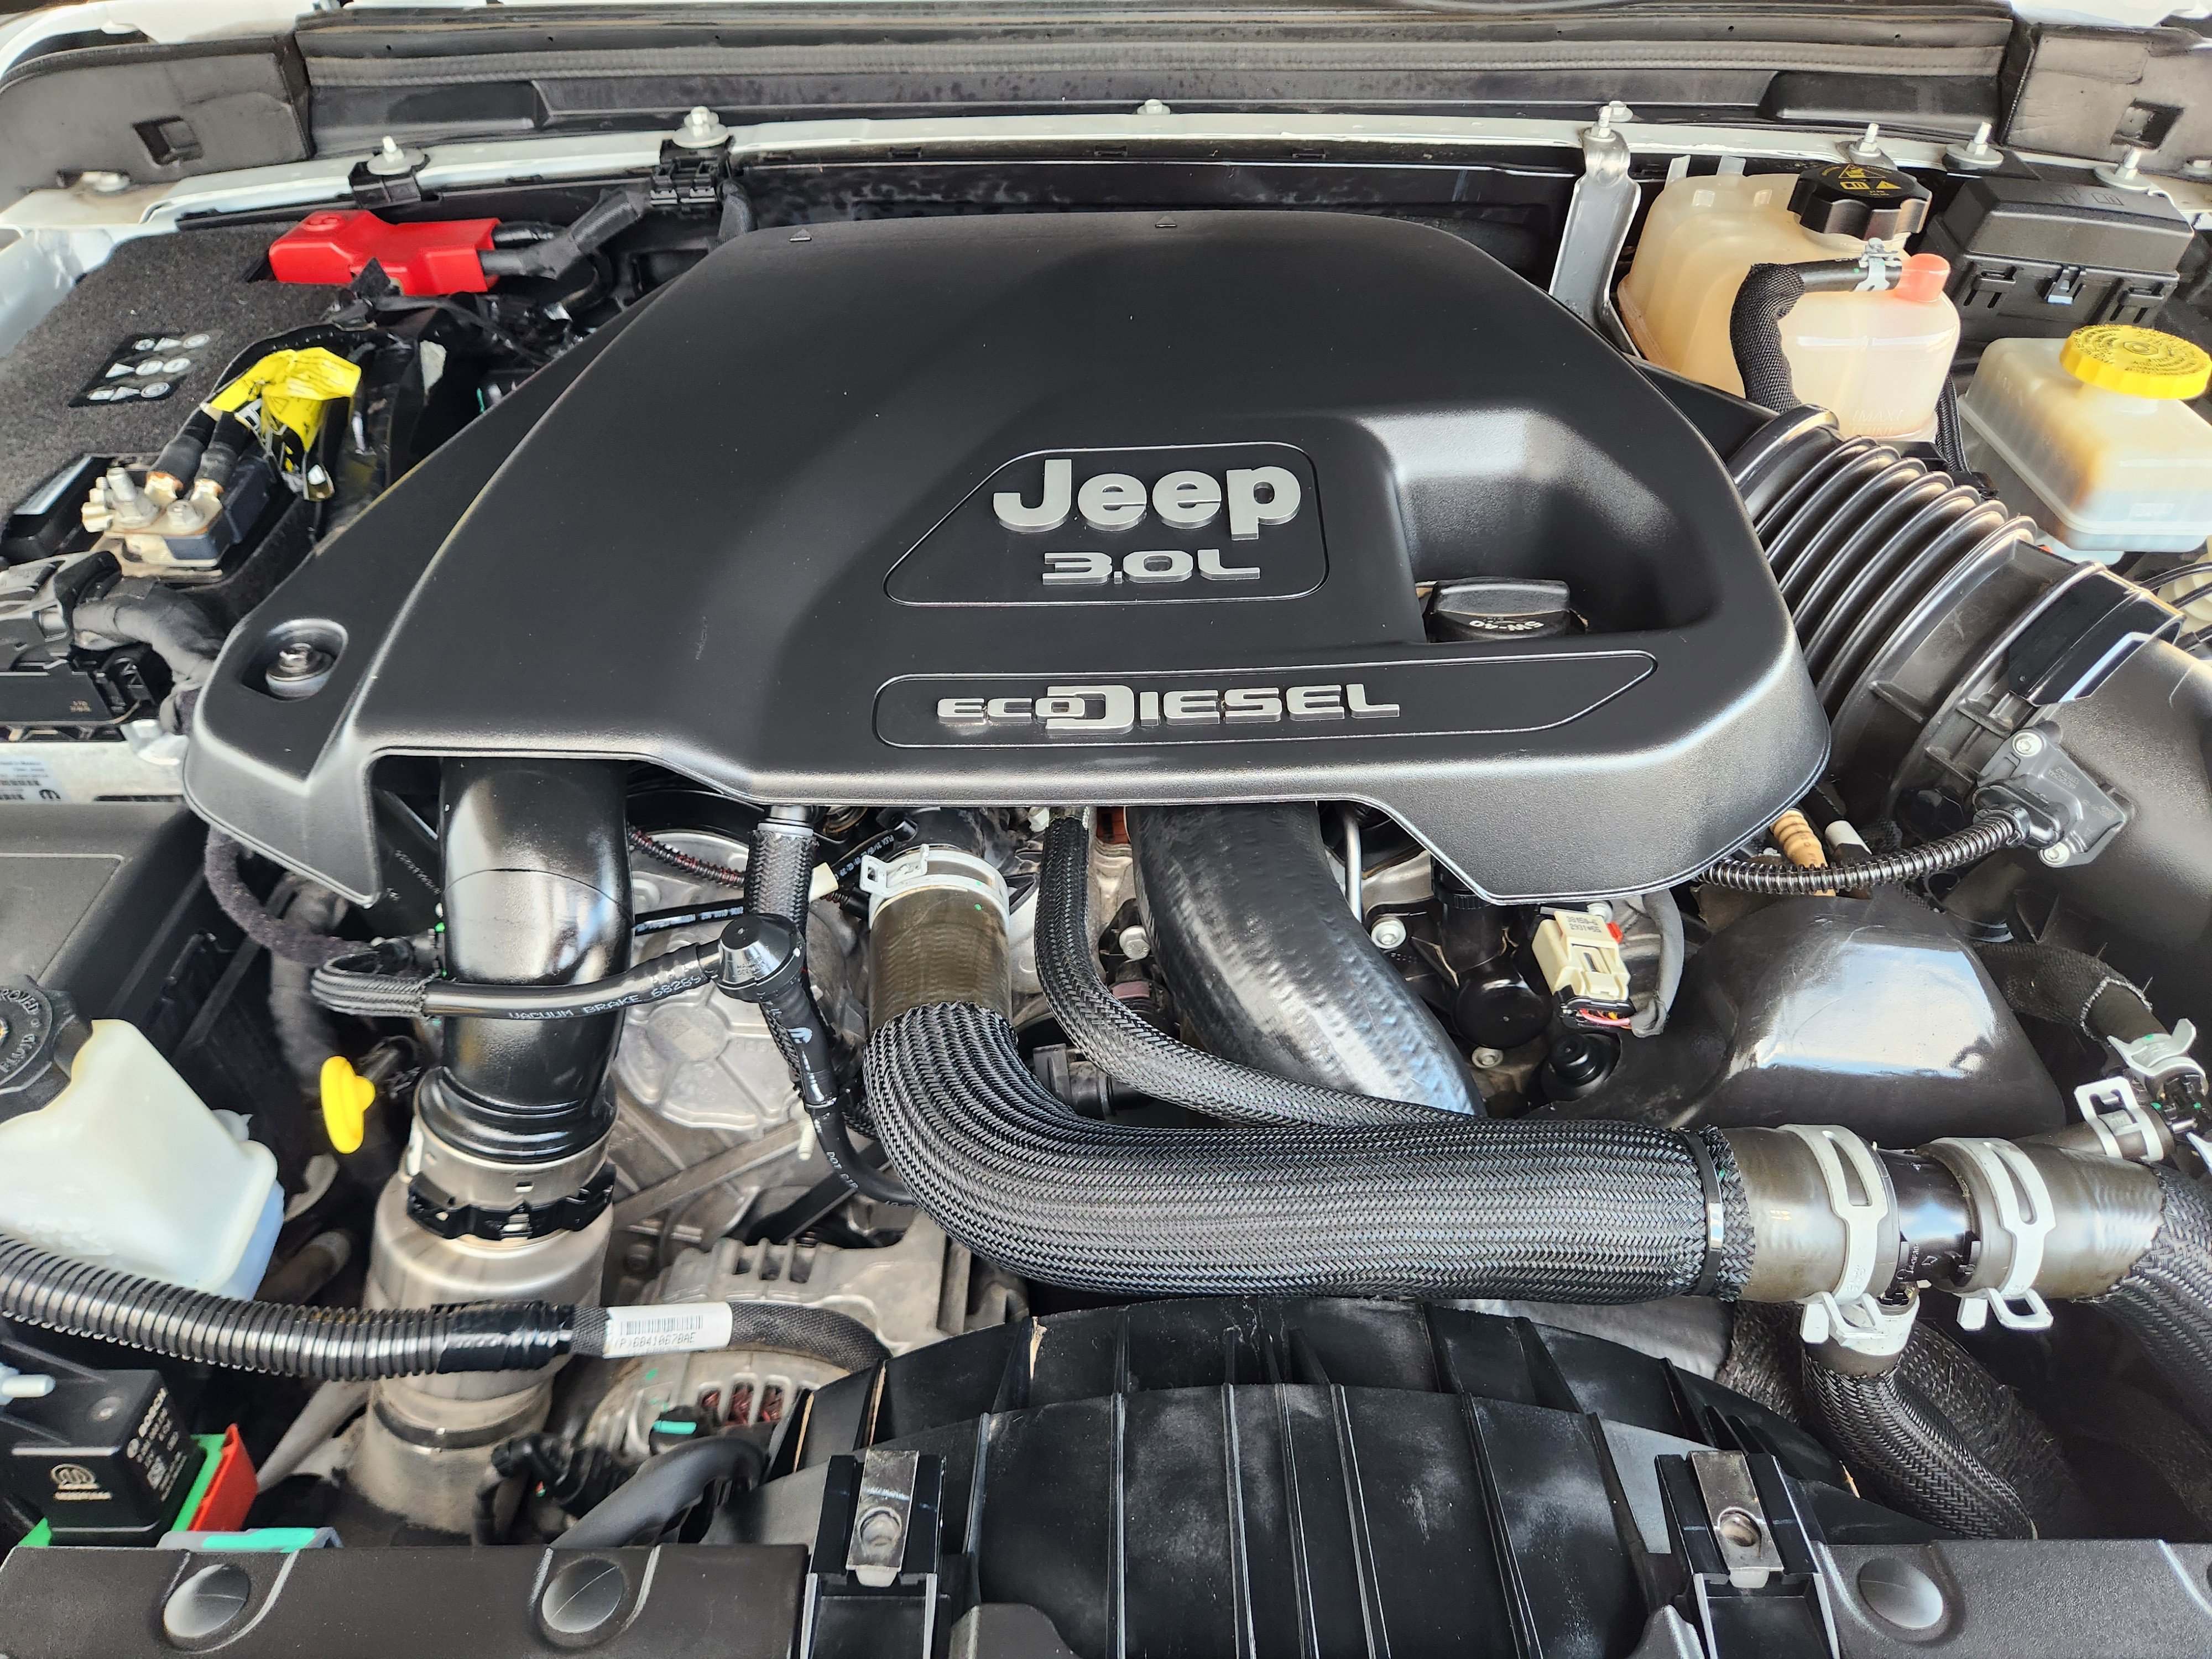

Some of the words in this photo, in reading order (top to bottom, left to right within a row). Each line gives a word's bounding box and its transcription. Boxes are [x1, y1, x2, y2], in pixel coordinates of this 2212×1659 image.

[993, 459, 1301, 540] Jeep
[1042, 549, 1260, 584] 3.0L
[1469, 620, 1545, 631] 5W-40
[508, 1009, 574, 1020] VACUUM
[582, 994, 641, 1014] BRAKE
